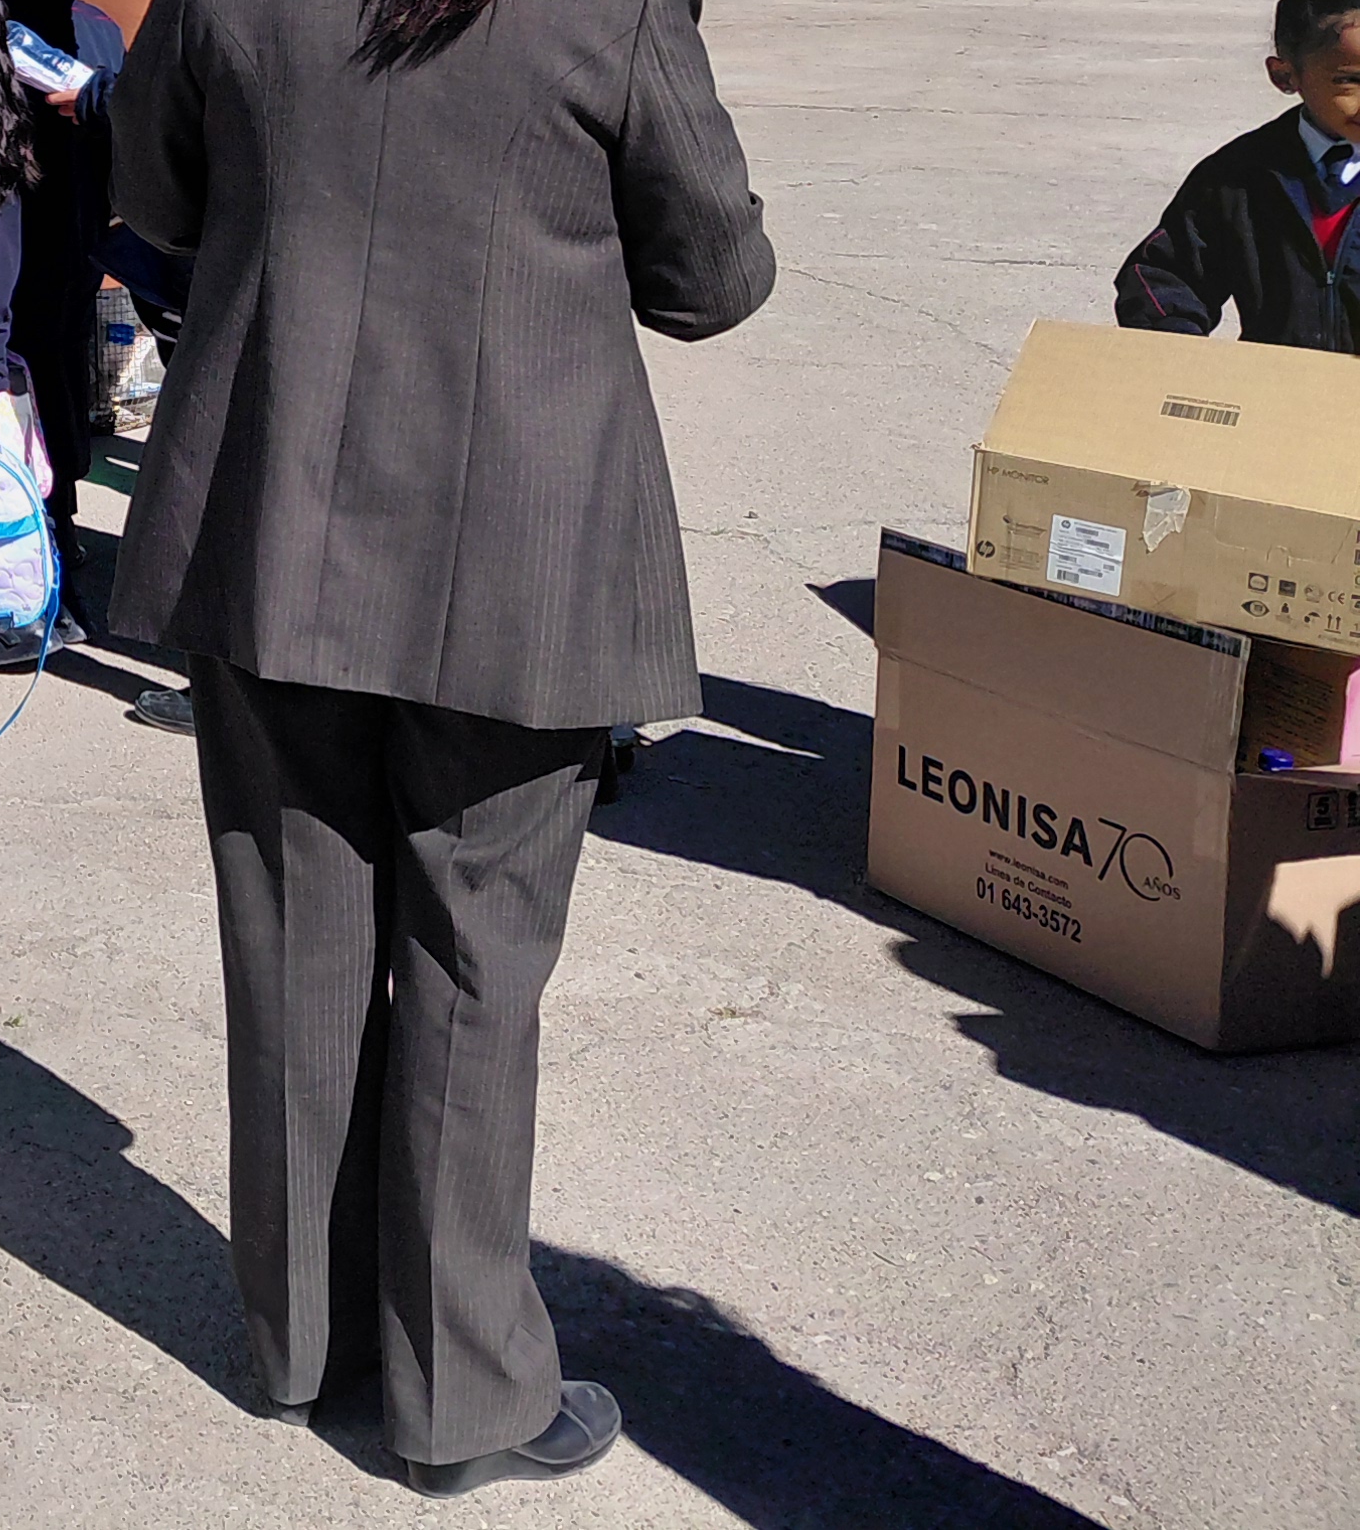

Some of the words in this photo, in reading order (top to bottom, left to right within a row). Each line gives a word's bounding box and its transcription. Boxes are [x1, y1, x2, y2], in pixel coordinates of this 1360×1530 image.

[1002, 469, 1050, 485] MONITOR
[897, 744, 1093, 867] LEONISA
[989, 849, 1069, 890] www.leonisa.com
[1142, 876, 1181, 900] AÑOS
[977, 876, 995, 904] 01
[1001, 888, 1082, 944] 643-3572
[1013, 876, 1025, 889] de
[1028, 881, 1072, 909] Contacto
